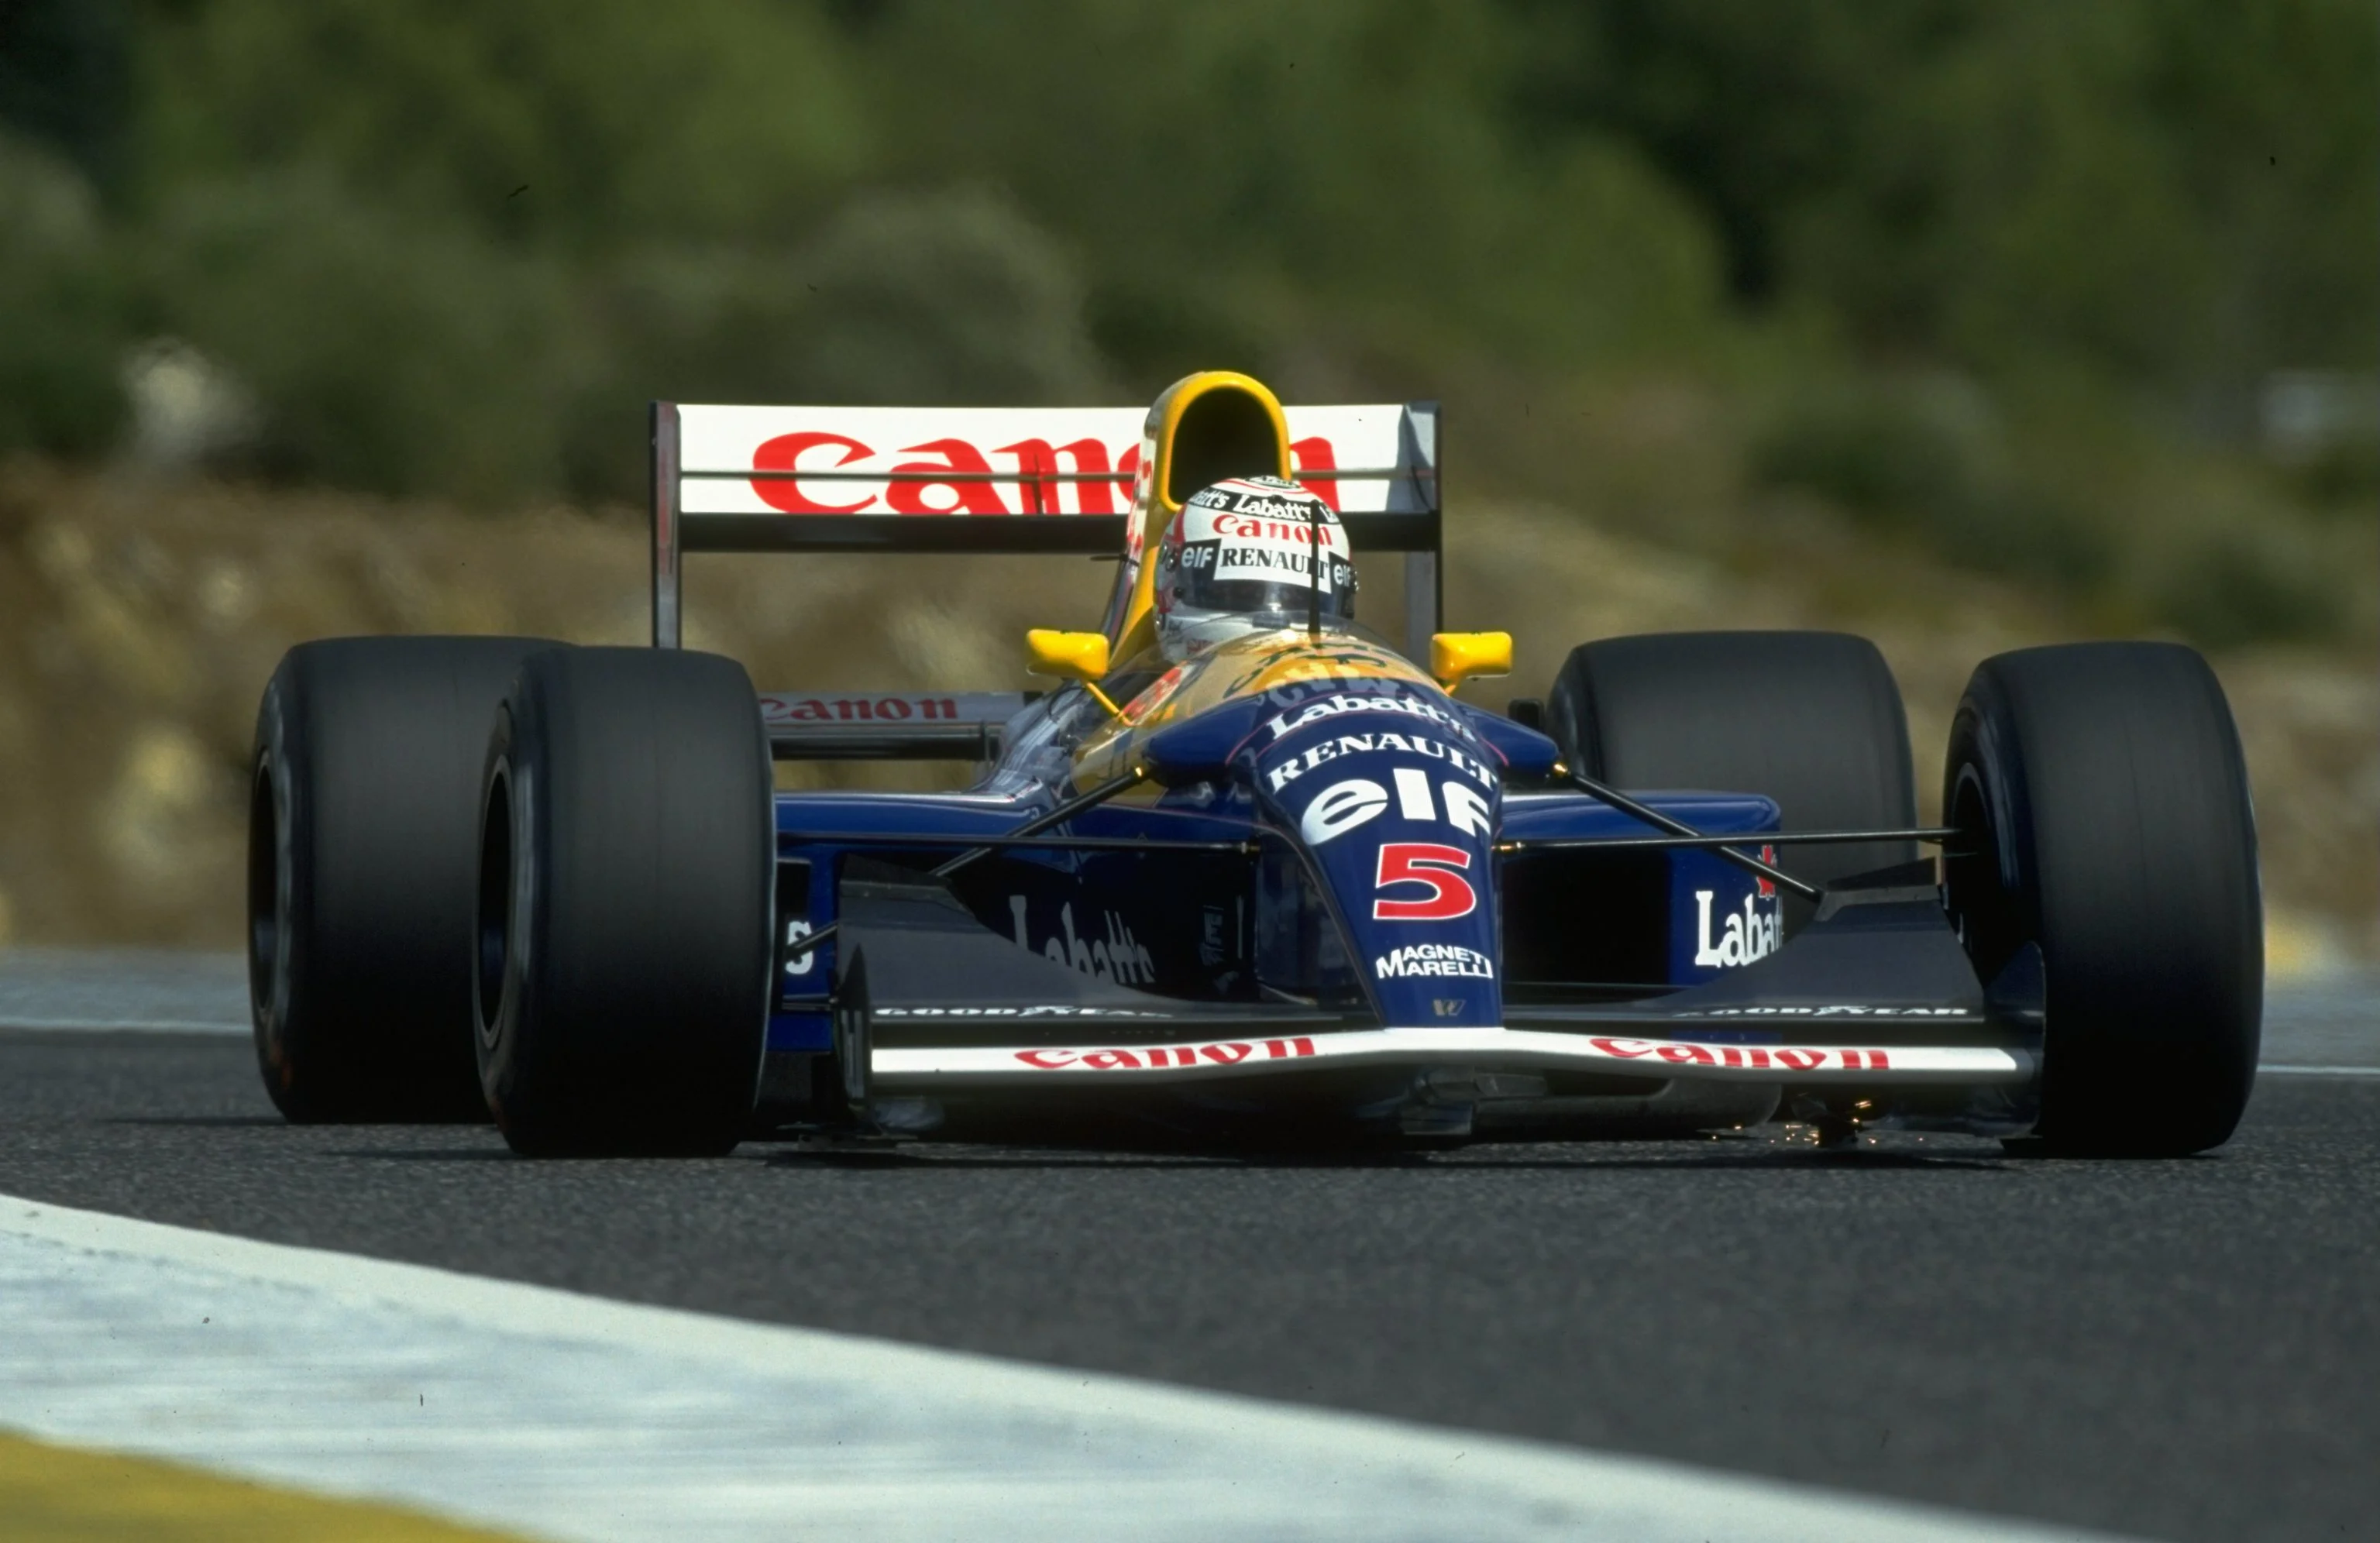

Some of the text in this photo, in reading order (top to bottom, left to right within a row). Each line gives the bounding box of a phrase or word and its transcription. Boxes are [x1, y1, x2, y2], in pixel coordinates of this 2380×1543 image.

[749, 431, 1339, 514] Can
[1212, 514, 1332, 546] Canon
[1181, 547, 1214, 569] elf
[1220, 548, 1329, 579] RENAUT
[1267, 734, 1498, 795] RENAULT
[1301, 768, 1491, 845] elf
[1373, 843, 1477, 920] 5
[1376, 944, 1493, 968] MAGNETI
[1376, 956, 1493, 979] MARELLI
[1013, 1036, 1316, 1070] Canon
[1589, 1037, 1890, 1070] Canon
